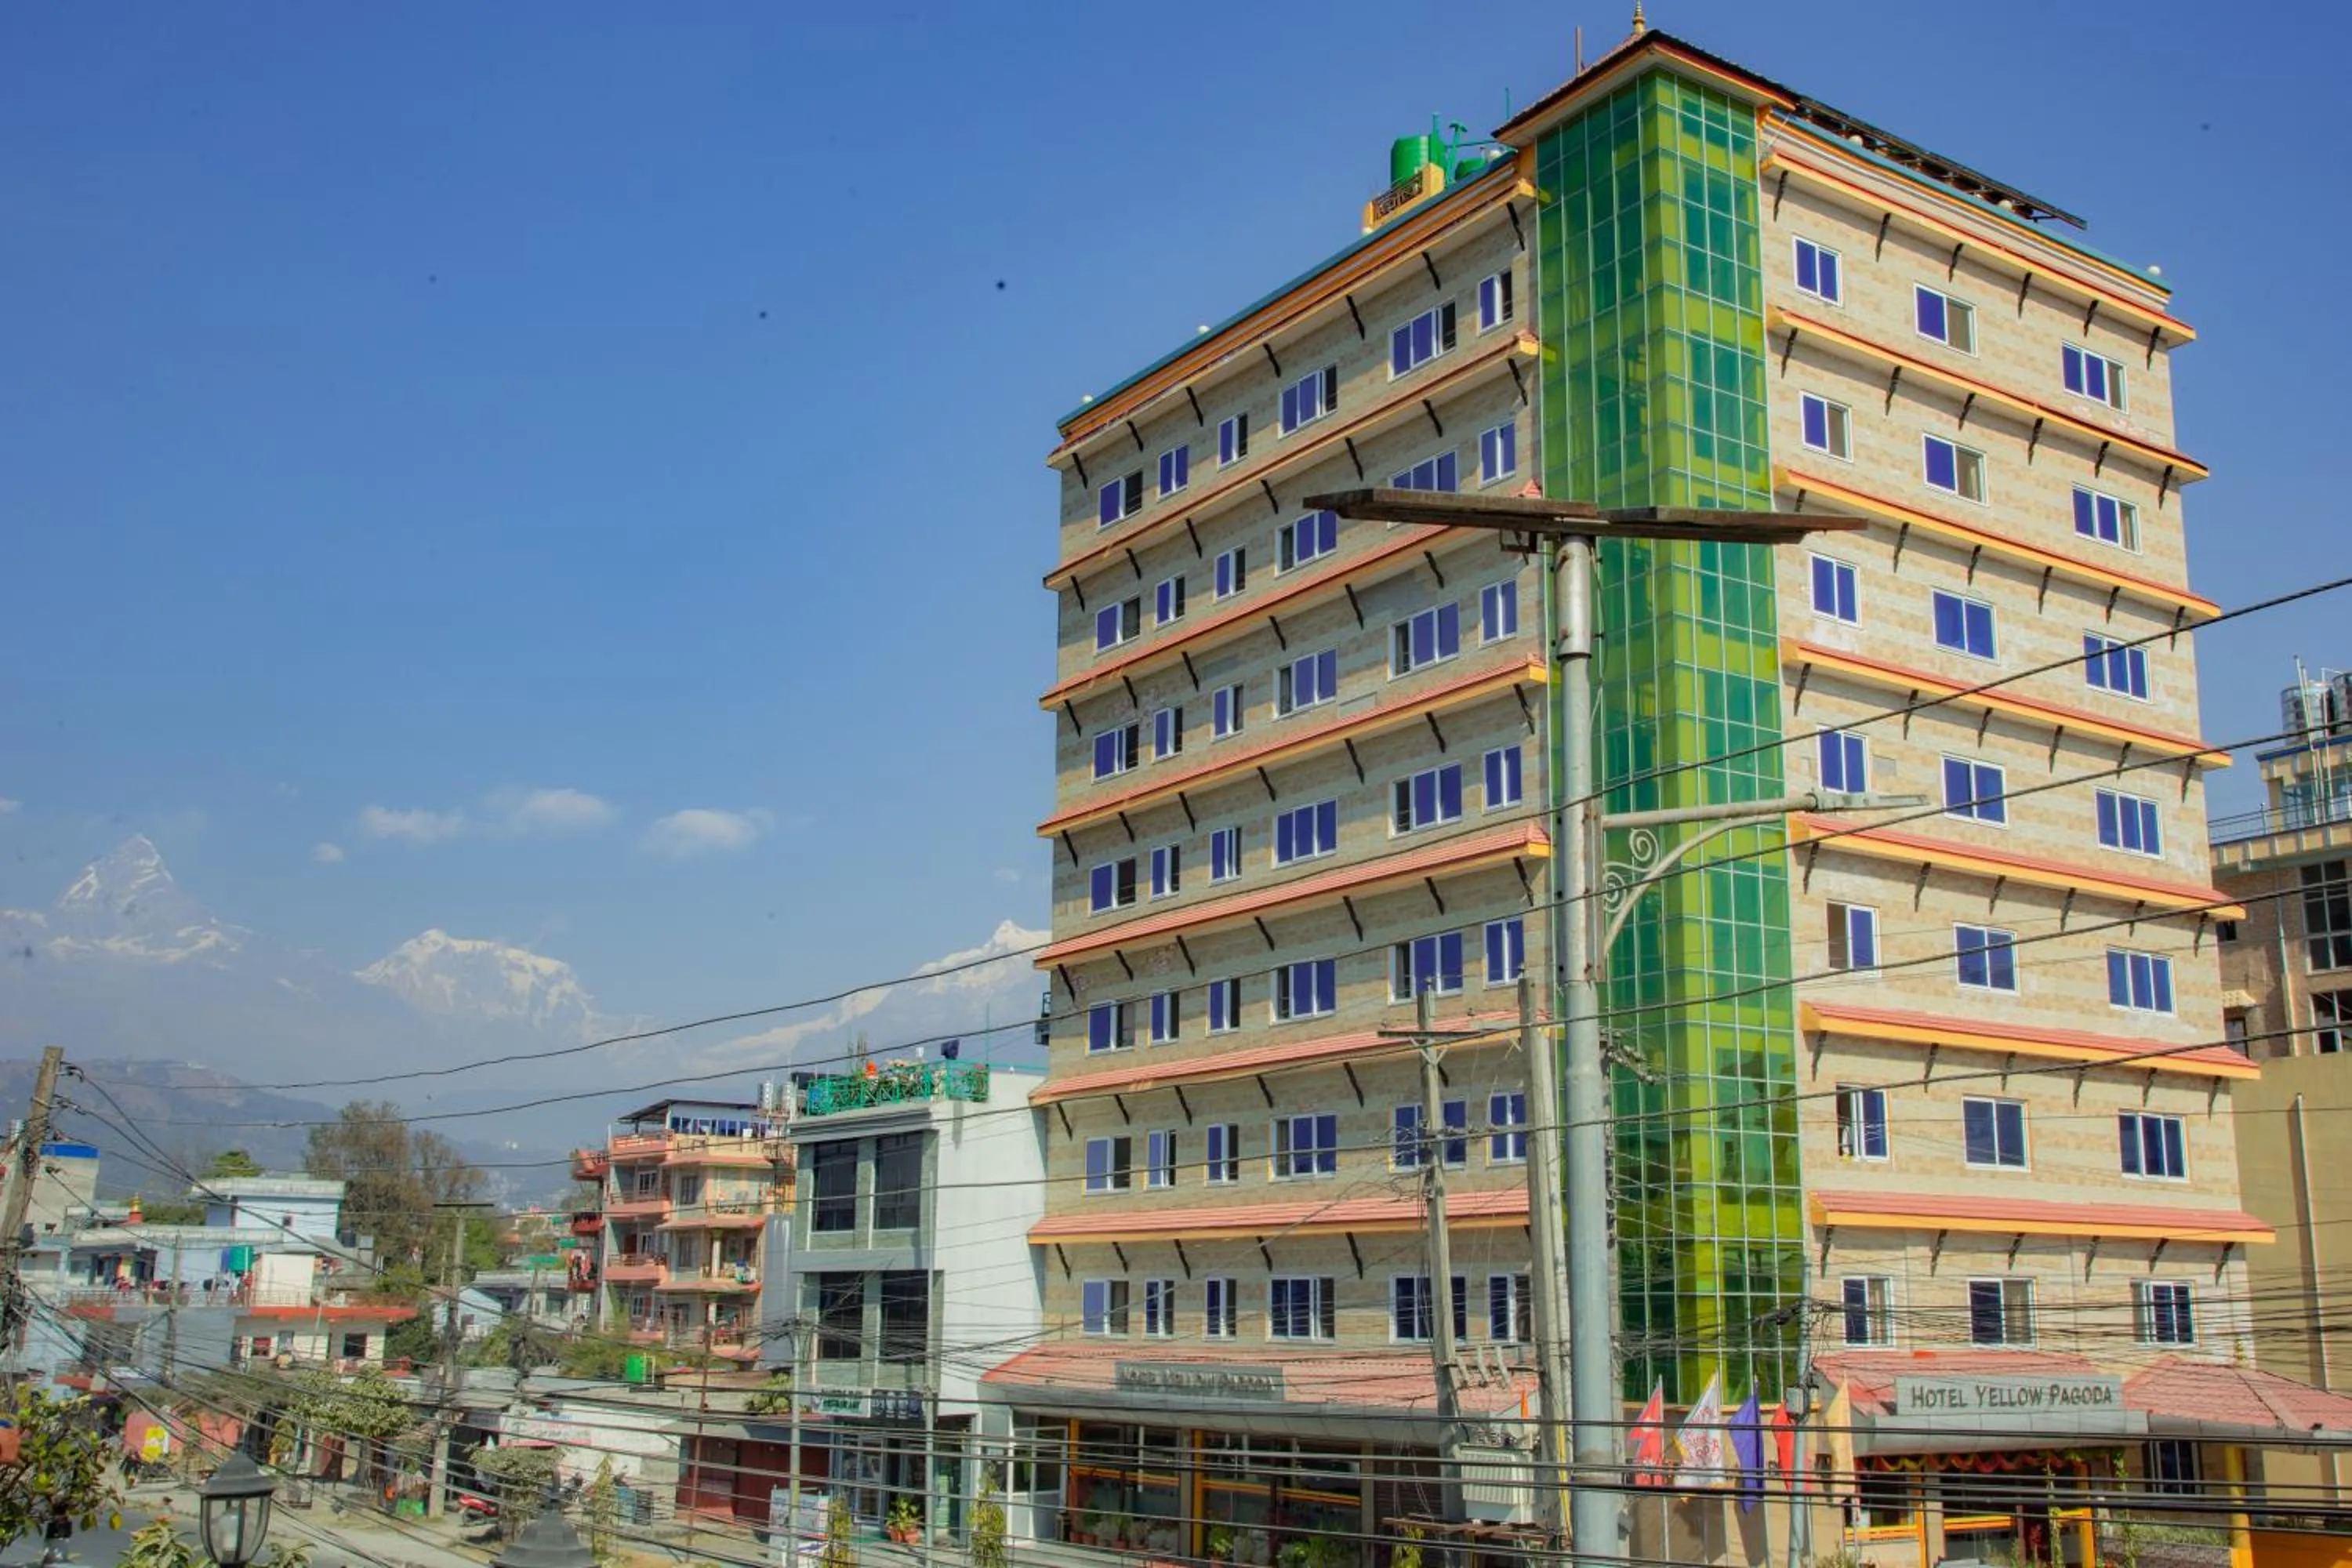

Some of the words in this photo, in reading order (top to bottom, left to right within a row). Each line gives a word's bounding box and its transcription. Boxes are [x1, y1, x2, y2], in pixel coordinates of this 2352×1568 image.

[1911, 1385, 1968, 1408] HOTEL
[1975, 1384, 2042, 1408] YELLOW
[2049, 1383, 2112, 1406] PAGODA
